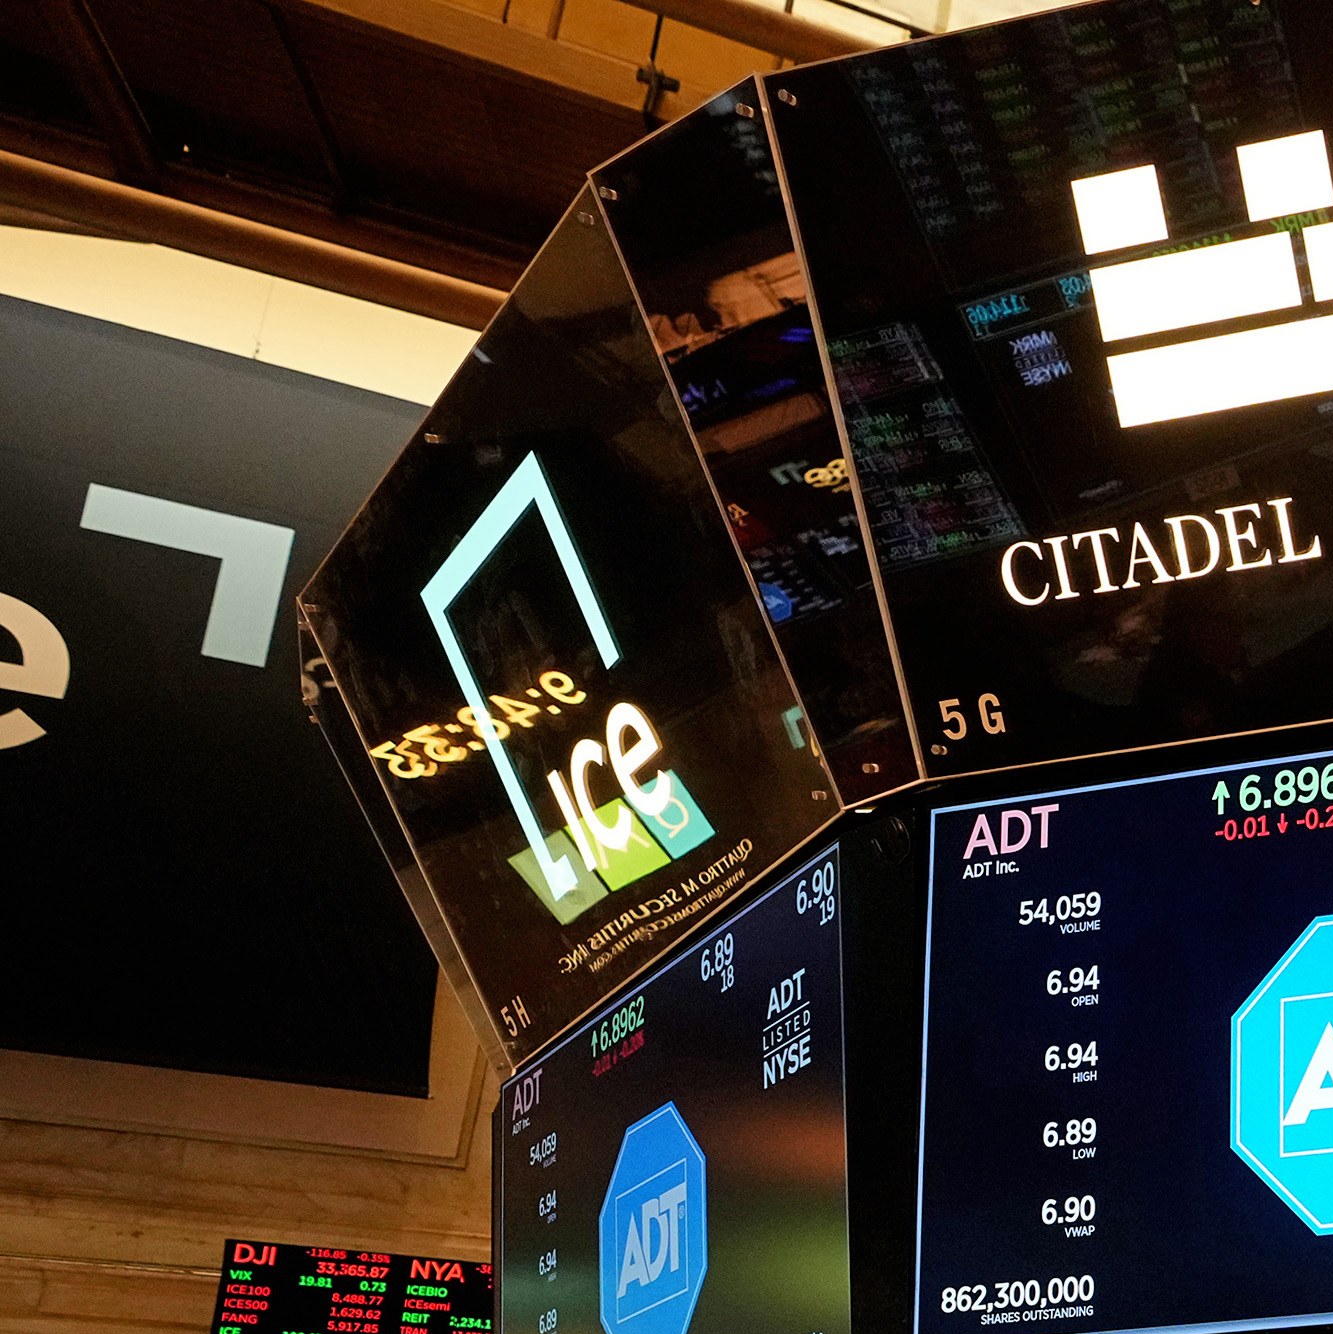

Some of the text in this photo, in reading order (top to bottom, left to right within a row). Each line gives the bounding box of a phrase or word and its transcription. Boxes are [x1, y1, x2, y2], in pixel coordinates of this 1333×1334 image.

[1000, 495, 1321, 610] CITADEL
[939, 693, 1005, 740] 5 G
[963, 804, 1059, 859] ADT
[1215, 815, 1270, 841] -0.01
[963, 861, 1019, 879] ADT Inc.
[1019, 892, 1101, 930] 54,059
[1060, 920, 1100, 934] VOLUME
[1047, 965, 1100, 995] 6.94
[1071, 994, 1098, 1007] OPEN
[501, 996, 531, 1036] 5 H
[599, 994, 644, 1054] 6.8962
[763, 1034, 811, 1089] NYSE
[1045, 1041, 1098, 1071] 6.94
[1073, 1070, 1097, 1083] HIGH
[1043, 1118, 1096, 1147] 6.89
[1073, 1147, 1096, 1159] LOW
[1042, 1195, 1095, 1225] 6.90
[1065, 1225, 1095, 1237] VWAP
[233, 1243, 277, 1266] DJI
[230, 1270, 252, 1280] VIX
[410, 1259, 465, 1283] NYA
[227, 1284, 271, 1296] ICE100
[941, 1275, 1094, 1316] 862,300,000
[224, 1298, 269, 1310] ICE500
[981, 1305, 1093, 1325] SHARES OUTSTANDING
[222, 1312, 258, 1324] FANG
[402, 1312, 430, 1323] REIT
